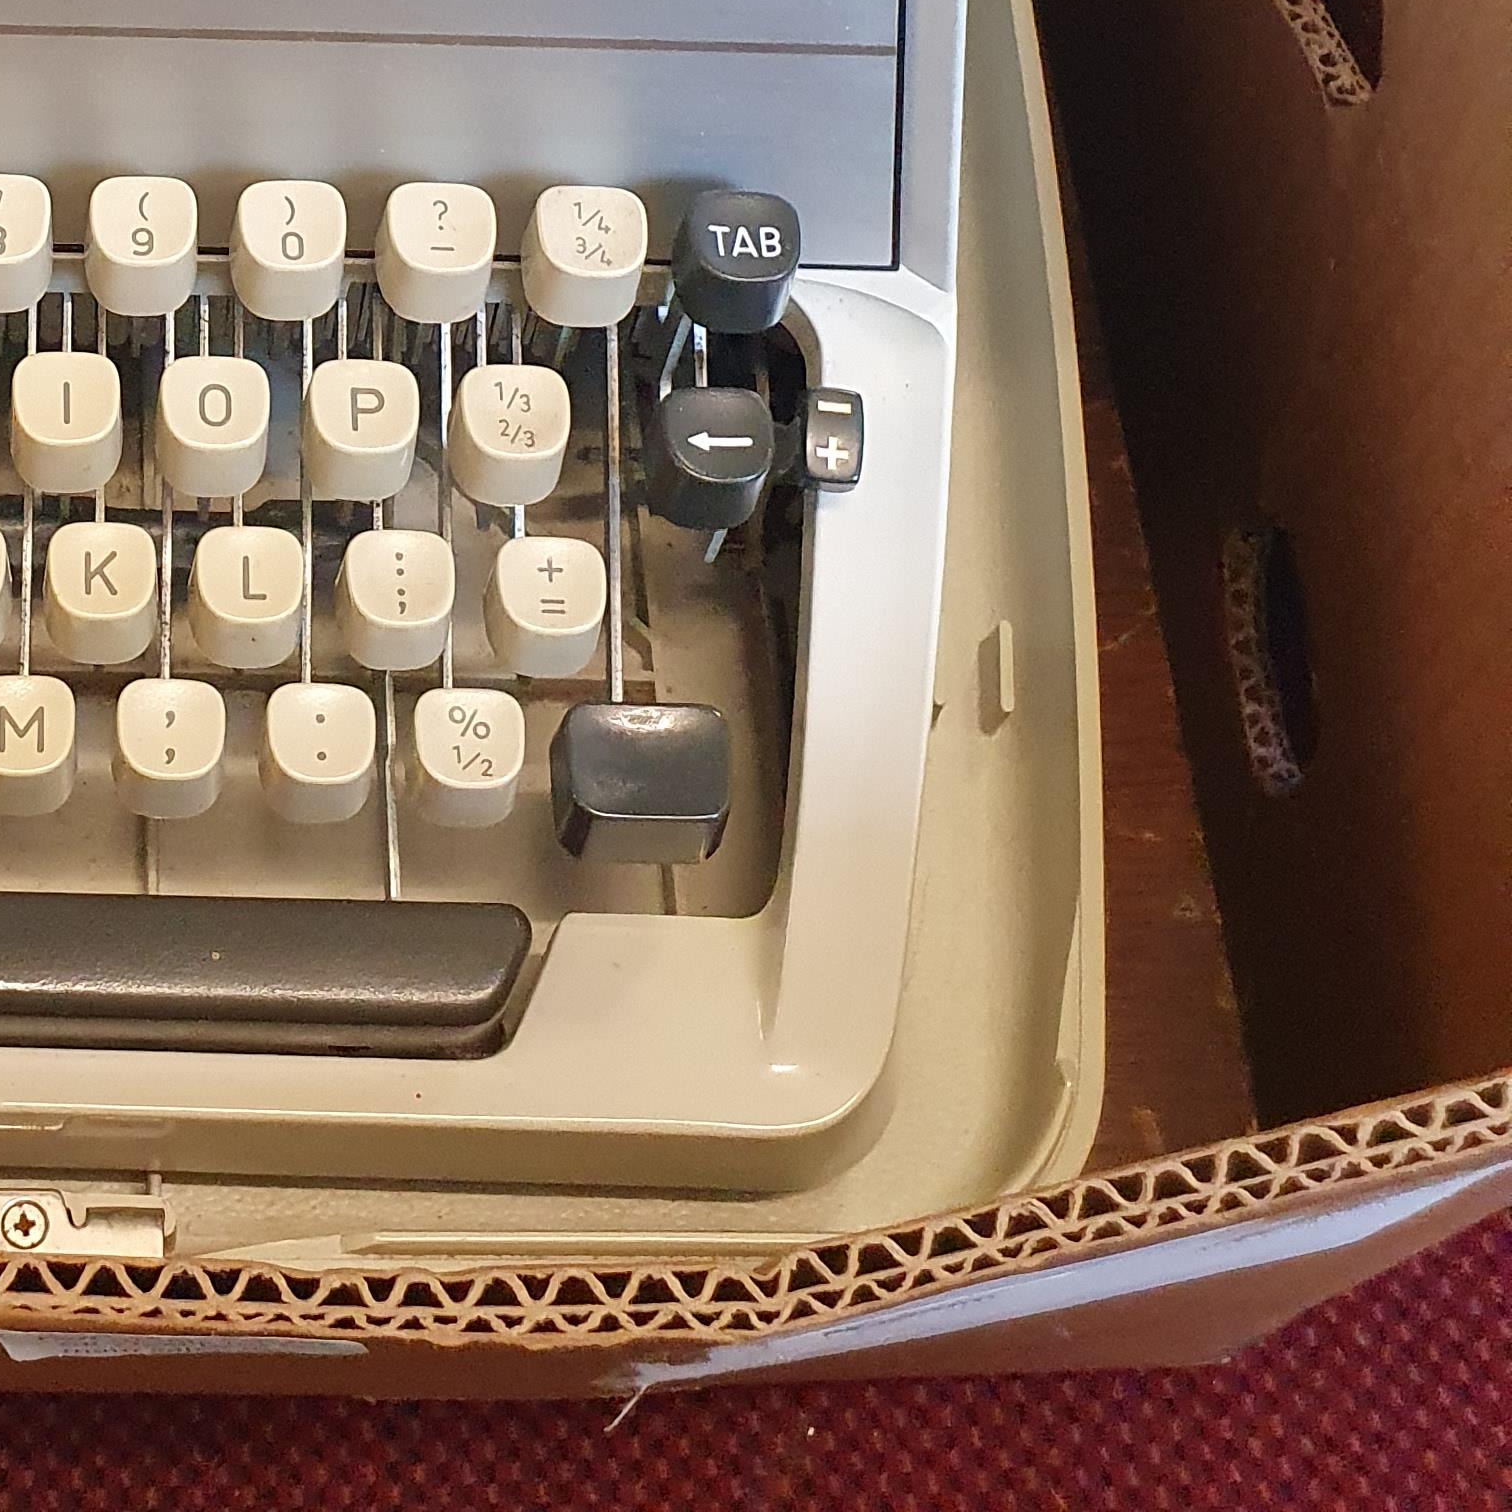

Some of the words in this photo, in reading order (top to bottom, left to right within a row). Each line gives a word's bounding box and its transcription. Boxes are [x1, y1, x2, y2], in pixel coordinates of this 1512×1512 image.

[138, 191, 150, 222] (
[284, 195, 296, 226] )
[432, 199, 449, 231] ?
[131, 227, 154, 257] 9
[281, 231, 305, 261] 0
[707, 224, 782, 258] TAB
[63, 381, 71, 425] I
[198, 383, 233, 427] O
[350, 386, 385, 432] P
[84, 550, 119, 596] K
[242, 555, 268, 601] L
[394, 551, 405, 577] :
[536, 558, 564, 584] +
[396, 588, 407, 615] ;
[539, 598, 567, 615] =
[448, 705, 491, 740] %
